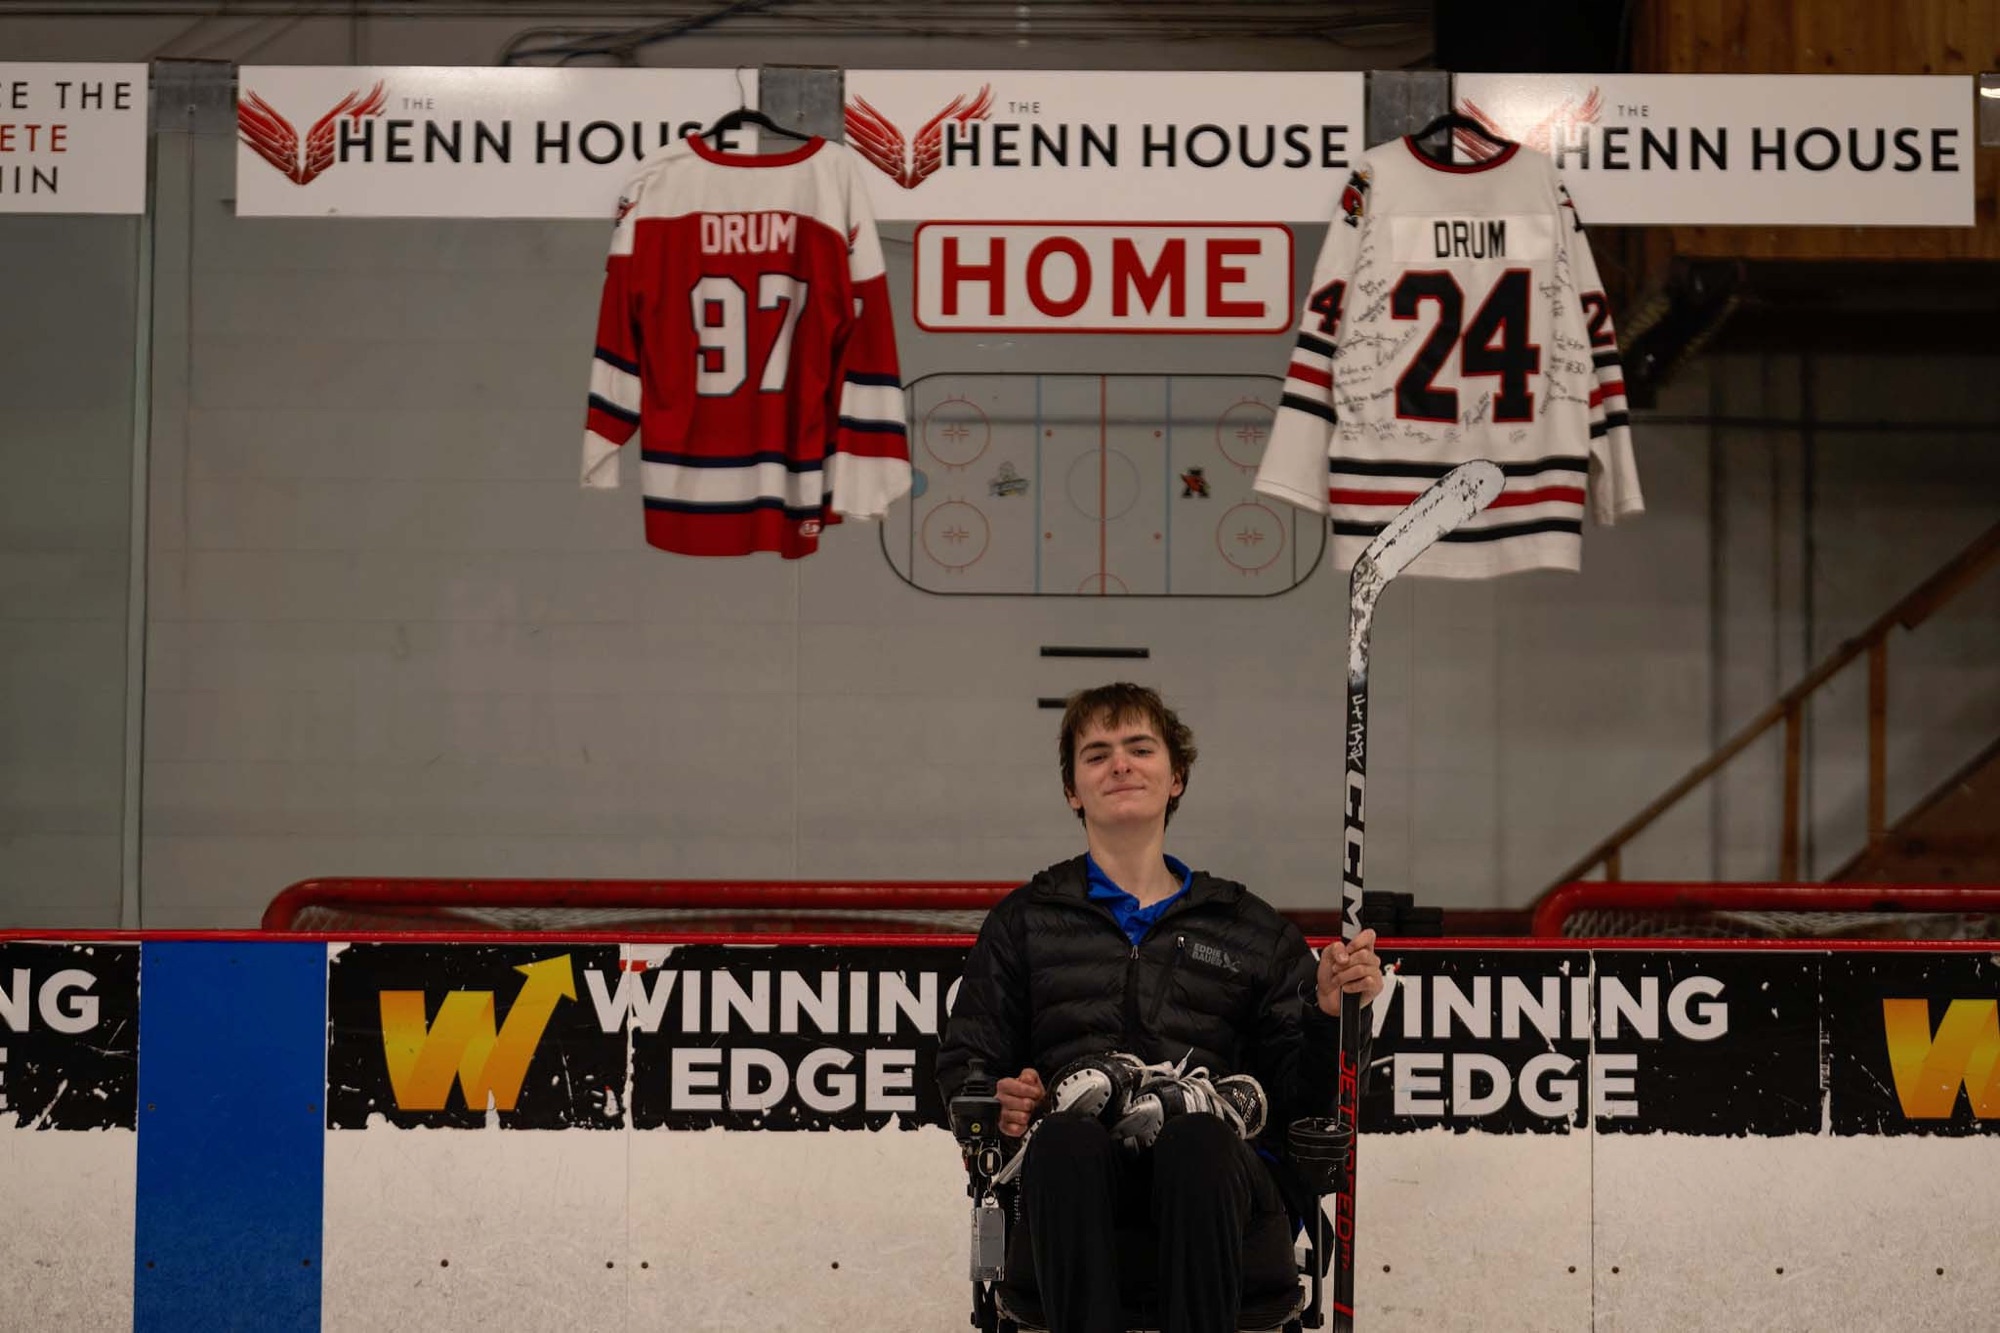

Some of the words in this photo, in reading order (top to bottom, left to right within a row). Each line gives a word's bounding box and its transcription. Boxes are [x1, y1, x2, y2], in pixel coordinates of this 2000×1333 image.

[0, 82, 28, 109] E
[55, 82, 131, 109] THE
[402, 97, 434, 109] THE
[1008, 102, 1041, 114] THE
[1618, 105, 1649, 117] THE
[0, 125, 67, 152] ETE
[339, 118, 510, 163] HENN
[946, 123, 1117, 167] HENN
[1143, 124, 1349, 168] HOUSE
[1554, 126, 1728, 171] HENN
[1752, 127, 1960, 172] HOUSE
[0, 166, 57, 194] IN
[701, 212, 797, 254] DRUM
[1433, 220, 1506, 259] DRUM
[941, 236, 1265, 318] HOME
[690, 272, 808, 397] 97
[1391, 267, 1541, 425] 24
[1341, 768, 1366, 941] CCM
[584, 970, 963, 1034] WINNIN
[671, 1047, 917, 1112] EDGE
[1393, 1052, 1639, 1117] EDGE
[1337, 1051, 1356, 1241] JETED
